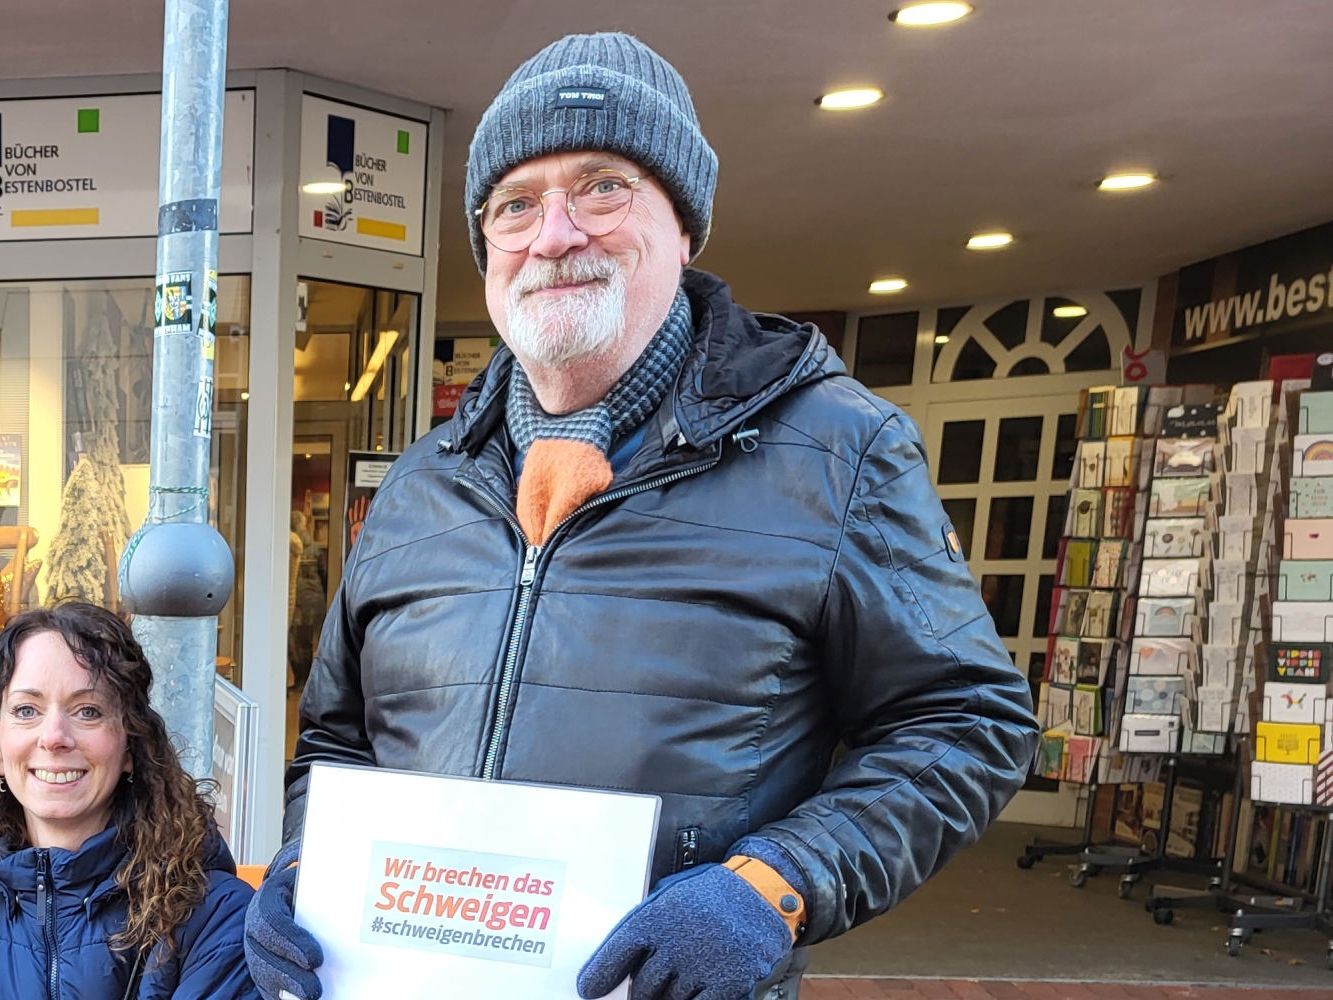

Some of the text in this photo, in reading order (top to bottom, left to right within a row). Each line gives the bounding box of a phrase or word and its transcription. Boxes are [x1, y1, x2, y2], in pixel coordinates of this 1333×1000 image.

[559, 92, 580, 100] TOM
[4, 143, 60, 160] BÜCHER
[4, 163, 37, 177] VON
[355, 152, 387, 172] BÜCHER
[354, 171, 374, 187] VON
[385, 857, 555, 896] Wir brechen das
[374, 881, 551, 931] Schweigen
[371, 916, 546, 954] #schweigenbrechen
